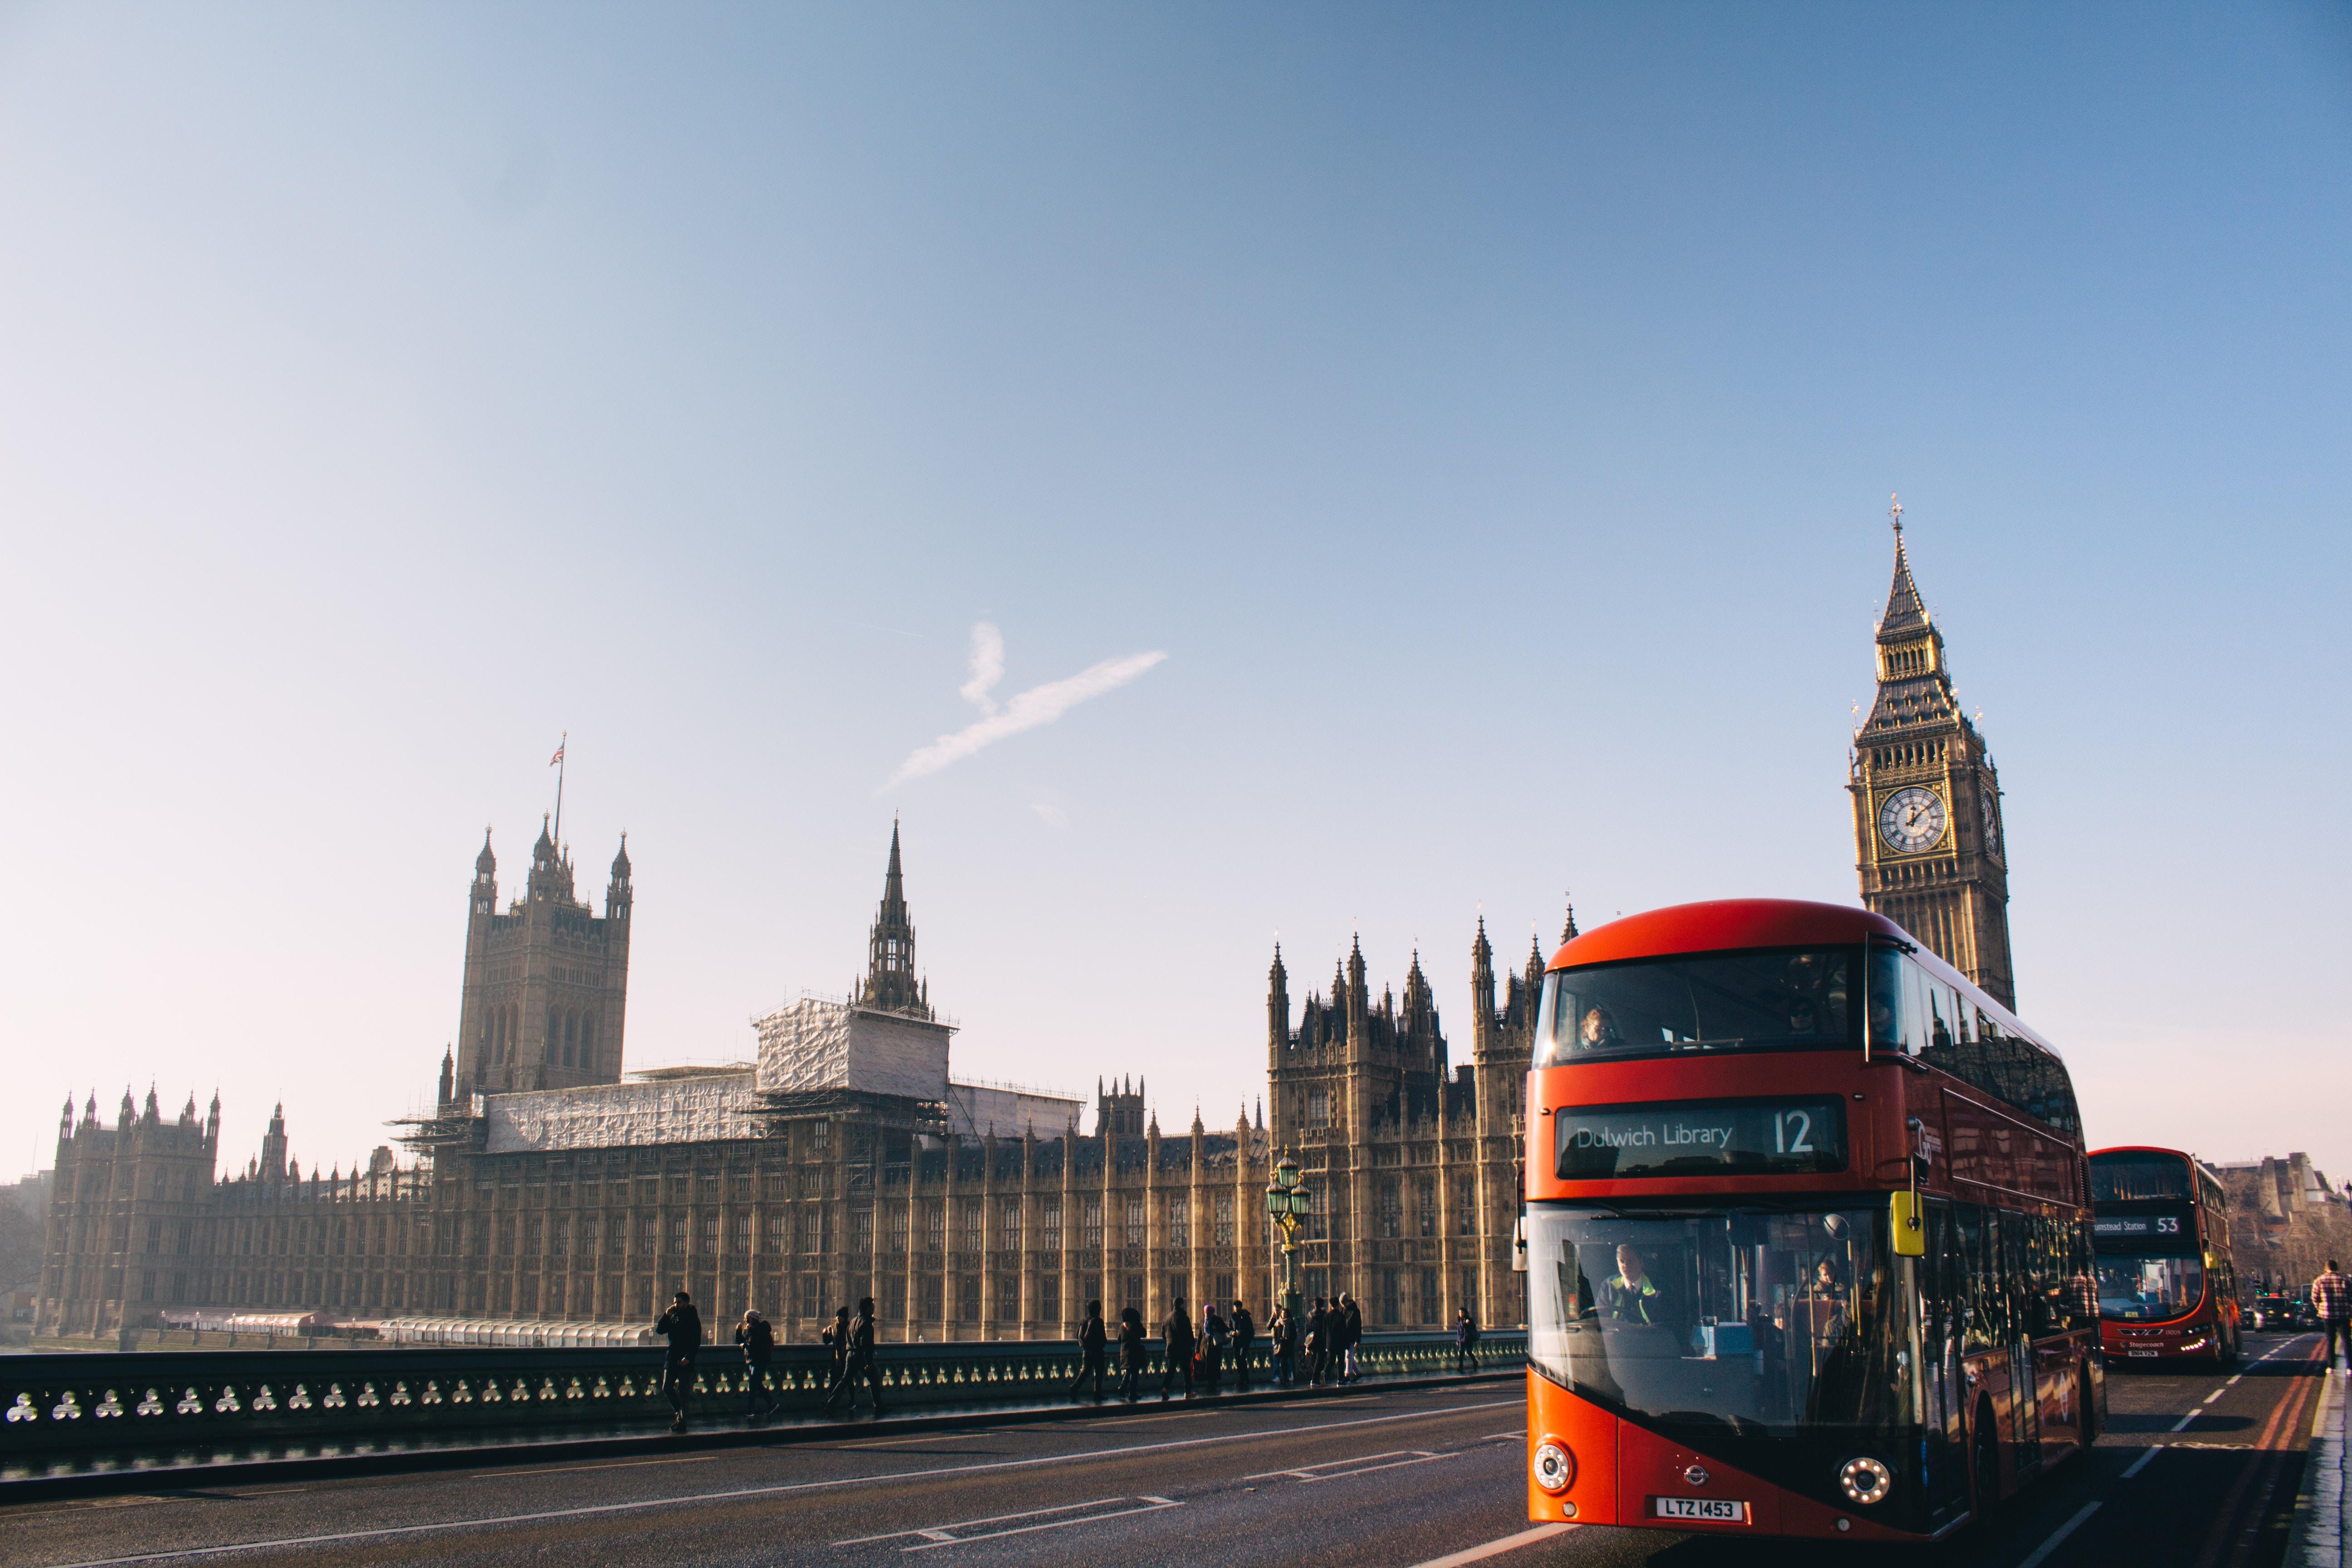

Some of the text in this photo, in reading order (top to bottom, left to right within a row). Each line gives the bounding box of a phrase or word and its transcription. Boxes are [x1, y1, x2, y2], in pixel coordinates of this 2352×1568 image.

[1577, 1124, 1733, 1148] Dulwich Library
[1774, 1109, 1814, 1153] 12
[2094, 1221, 2146, 1231] umstead Station
[2157, 1217, 2178, 1232] 53
[1666, 1500, 1733, 1517] LTZ 1453
